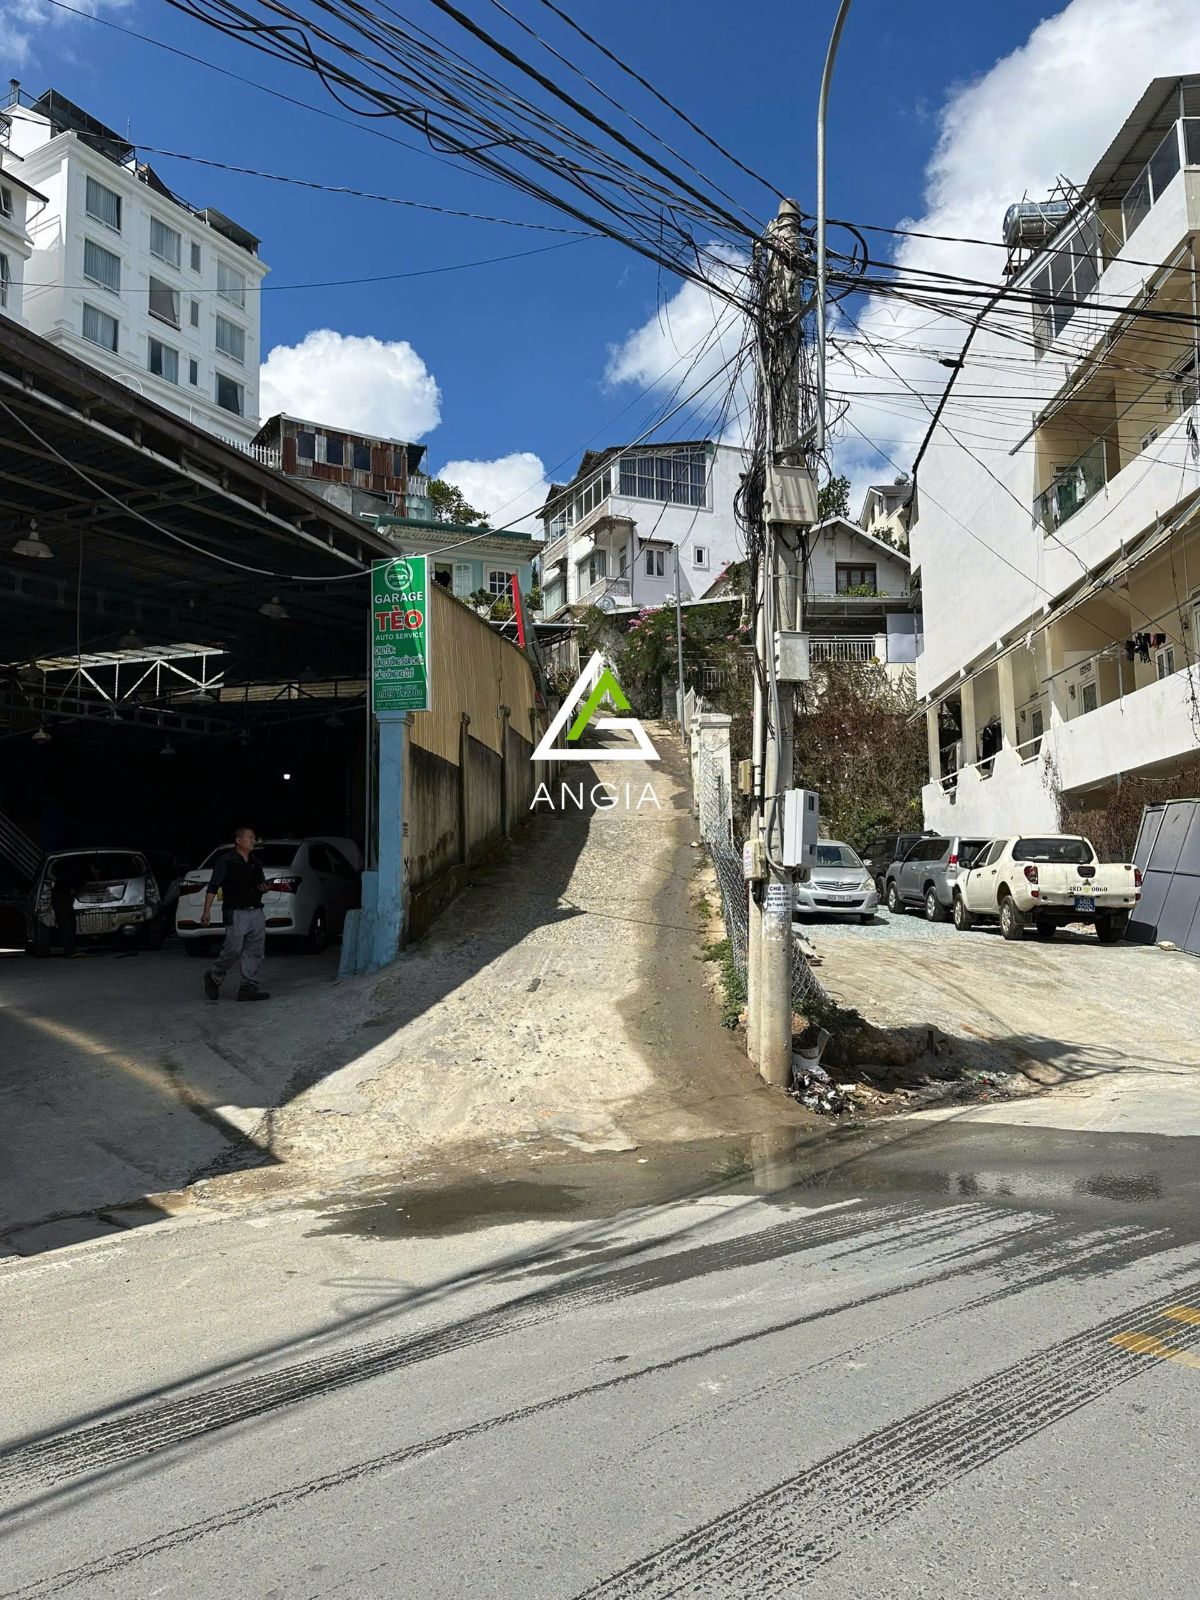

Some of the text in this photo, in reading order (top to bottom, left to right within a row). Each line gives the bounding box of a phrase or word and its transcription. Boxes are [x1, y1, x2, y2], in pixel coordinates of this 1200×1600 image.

[374, 591, 423, 604] GARAGE
[375, 605, 424, 632] TÈO
[375, 631, 423, 641] AUTO SERVICE
